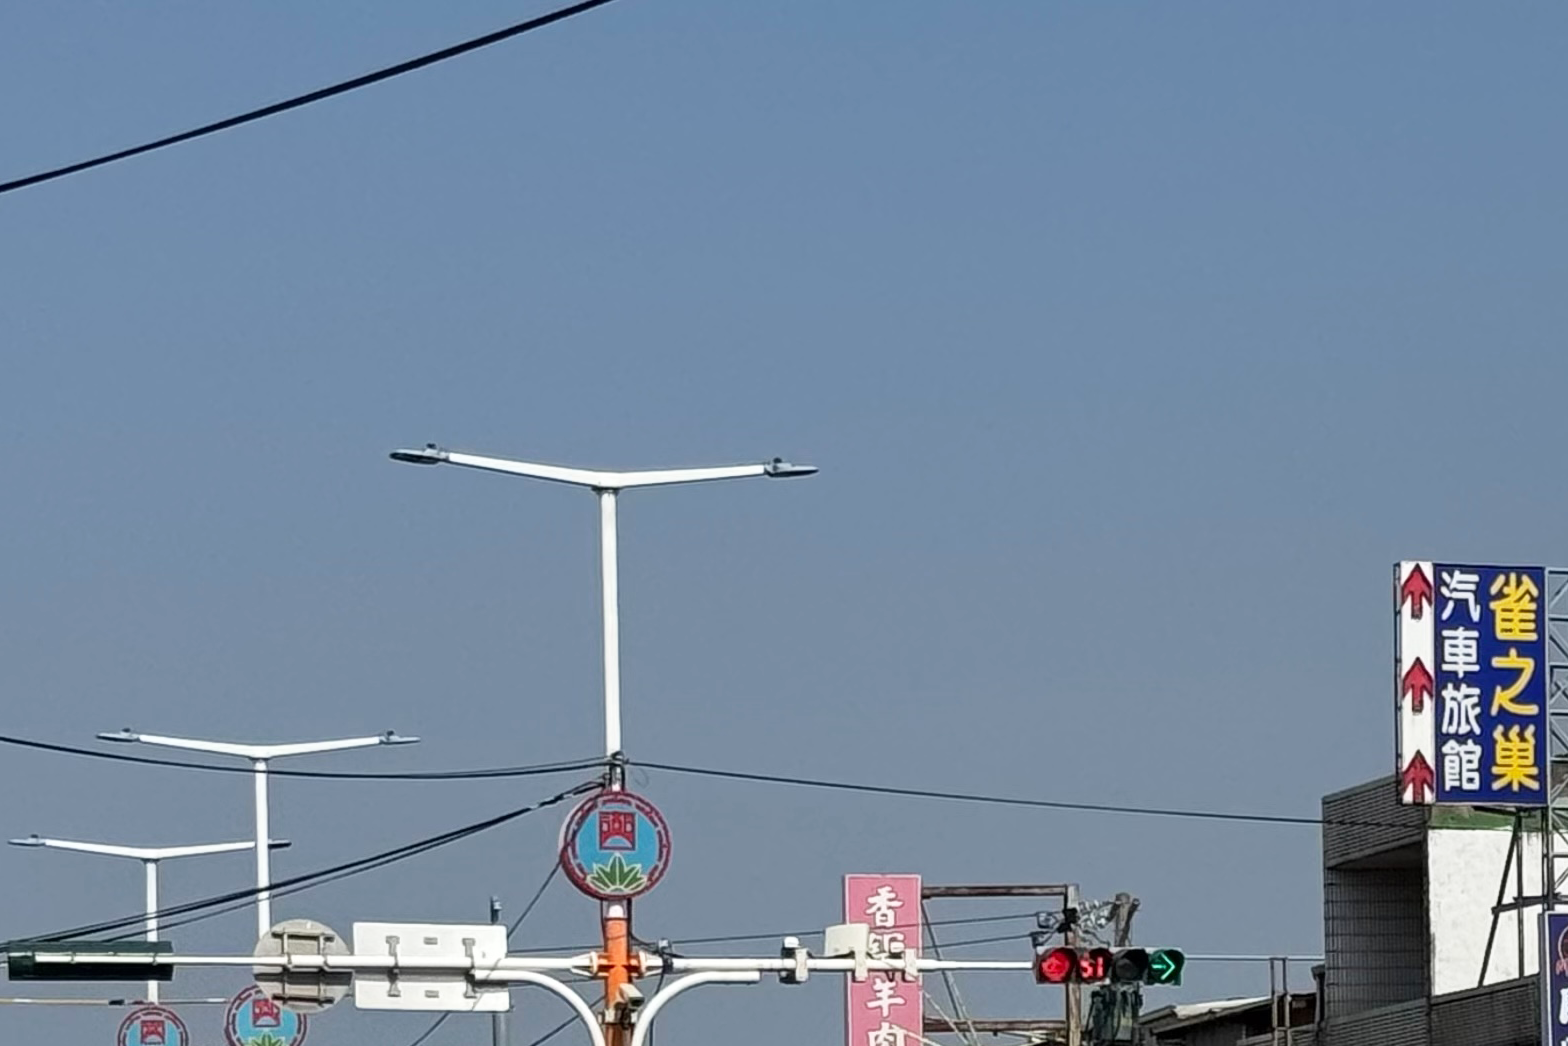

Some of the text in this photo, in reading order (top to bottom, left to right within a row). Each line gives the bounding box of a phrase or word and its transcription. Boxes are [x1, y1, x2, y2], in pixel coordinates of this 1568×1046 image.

[1440, 570, 1482, 791] 汽車旅館
[1489, 572, 1540, 792] 雀之巢
